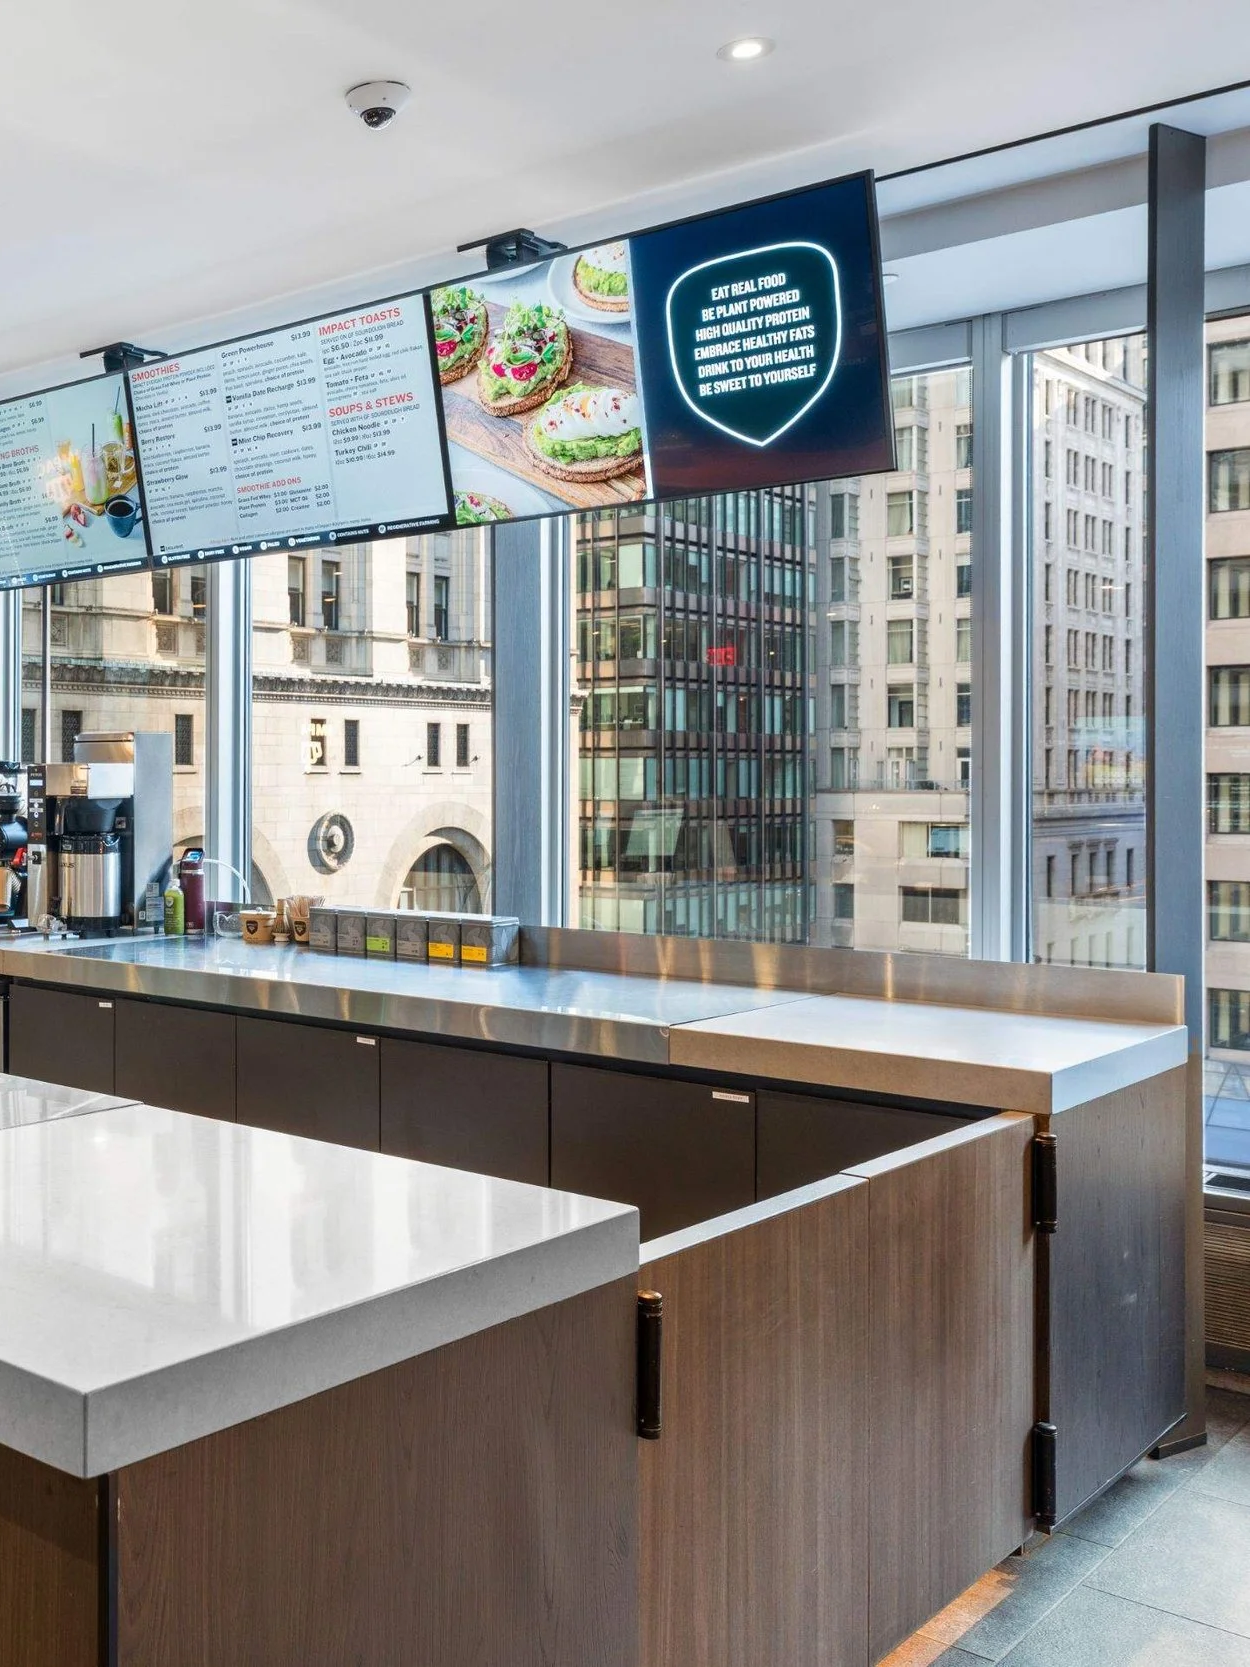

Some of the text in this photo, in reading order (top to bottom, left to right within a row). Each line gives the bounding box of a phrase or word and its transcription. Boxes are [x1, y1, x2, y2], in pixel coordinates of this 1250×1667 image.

[711, 273, 786, 301] EAT REAL FOOD
[701, 289, 800, 322] BE PLANT POWERED
[319, 307, 400, 336] IMPACT TOASTS
[355, 324, 386, 336] SOURDOUGH
[387, 320, 403, 328] BREAD
[695, 306, 810, 342] HIGH QUALITY PROTEIN
[221, 349, 238, 358] Green
[239, 340, 273, 354] Powerhouse
[694, 325, 815, 360] EMBRACE HEALTHY FATS
[323, 349, 367, 365] Egg Avocado
[698, 344, 814, 378] DRINK TO YOUR HEALTH
[131, 363, 180, 382] SMOOTHIES
[326, 374, 368, 388] Tomato Feta
[699, 363, 816, 397] BE SWEET TO YOURSELF
[232, 392, 251, 401] Vanilla
[253, 388, 266, 397] Date
[266, 382, 294, 393] Recharge
[329, 392, 413, 417] SOUPS & STEWS
[330, 418, 349, 426] SERVED
[371, 407, 402, 418] SOURDOUGH
[403, 404, 420, 412] BREAD
[266, 428, 293, 438] Recovery
[332, 421, 380, 435] Chicken Noodle
[11, 444, 39, 457] BROTHS
[141, 437, 154, 445] Berry
[334, 444, 371, 456] Turkey Chili
[237, 477, 301, 493] SMOOTHIE ADD ONS
